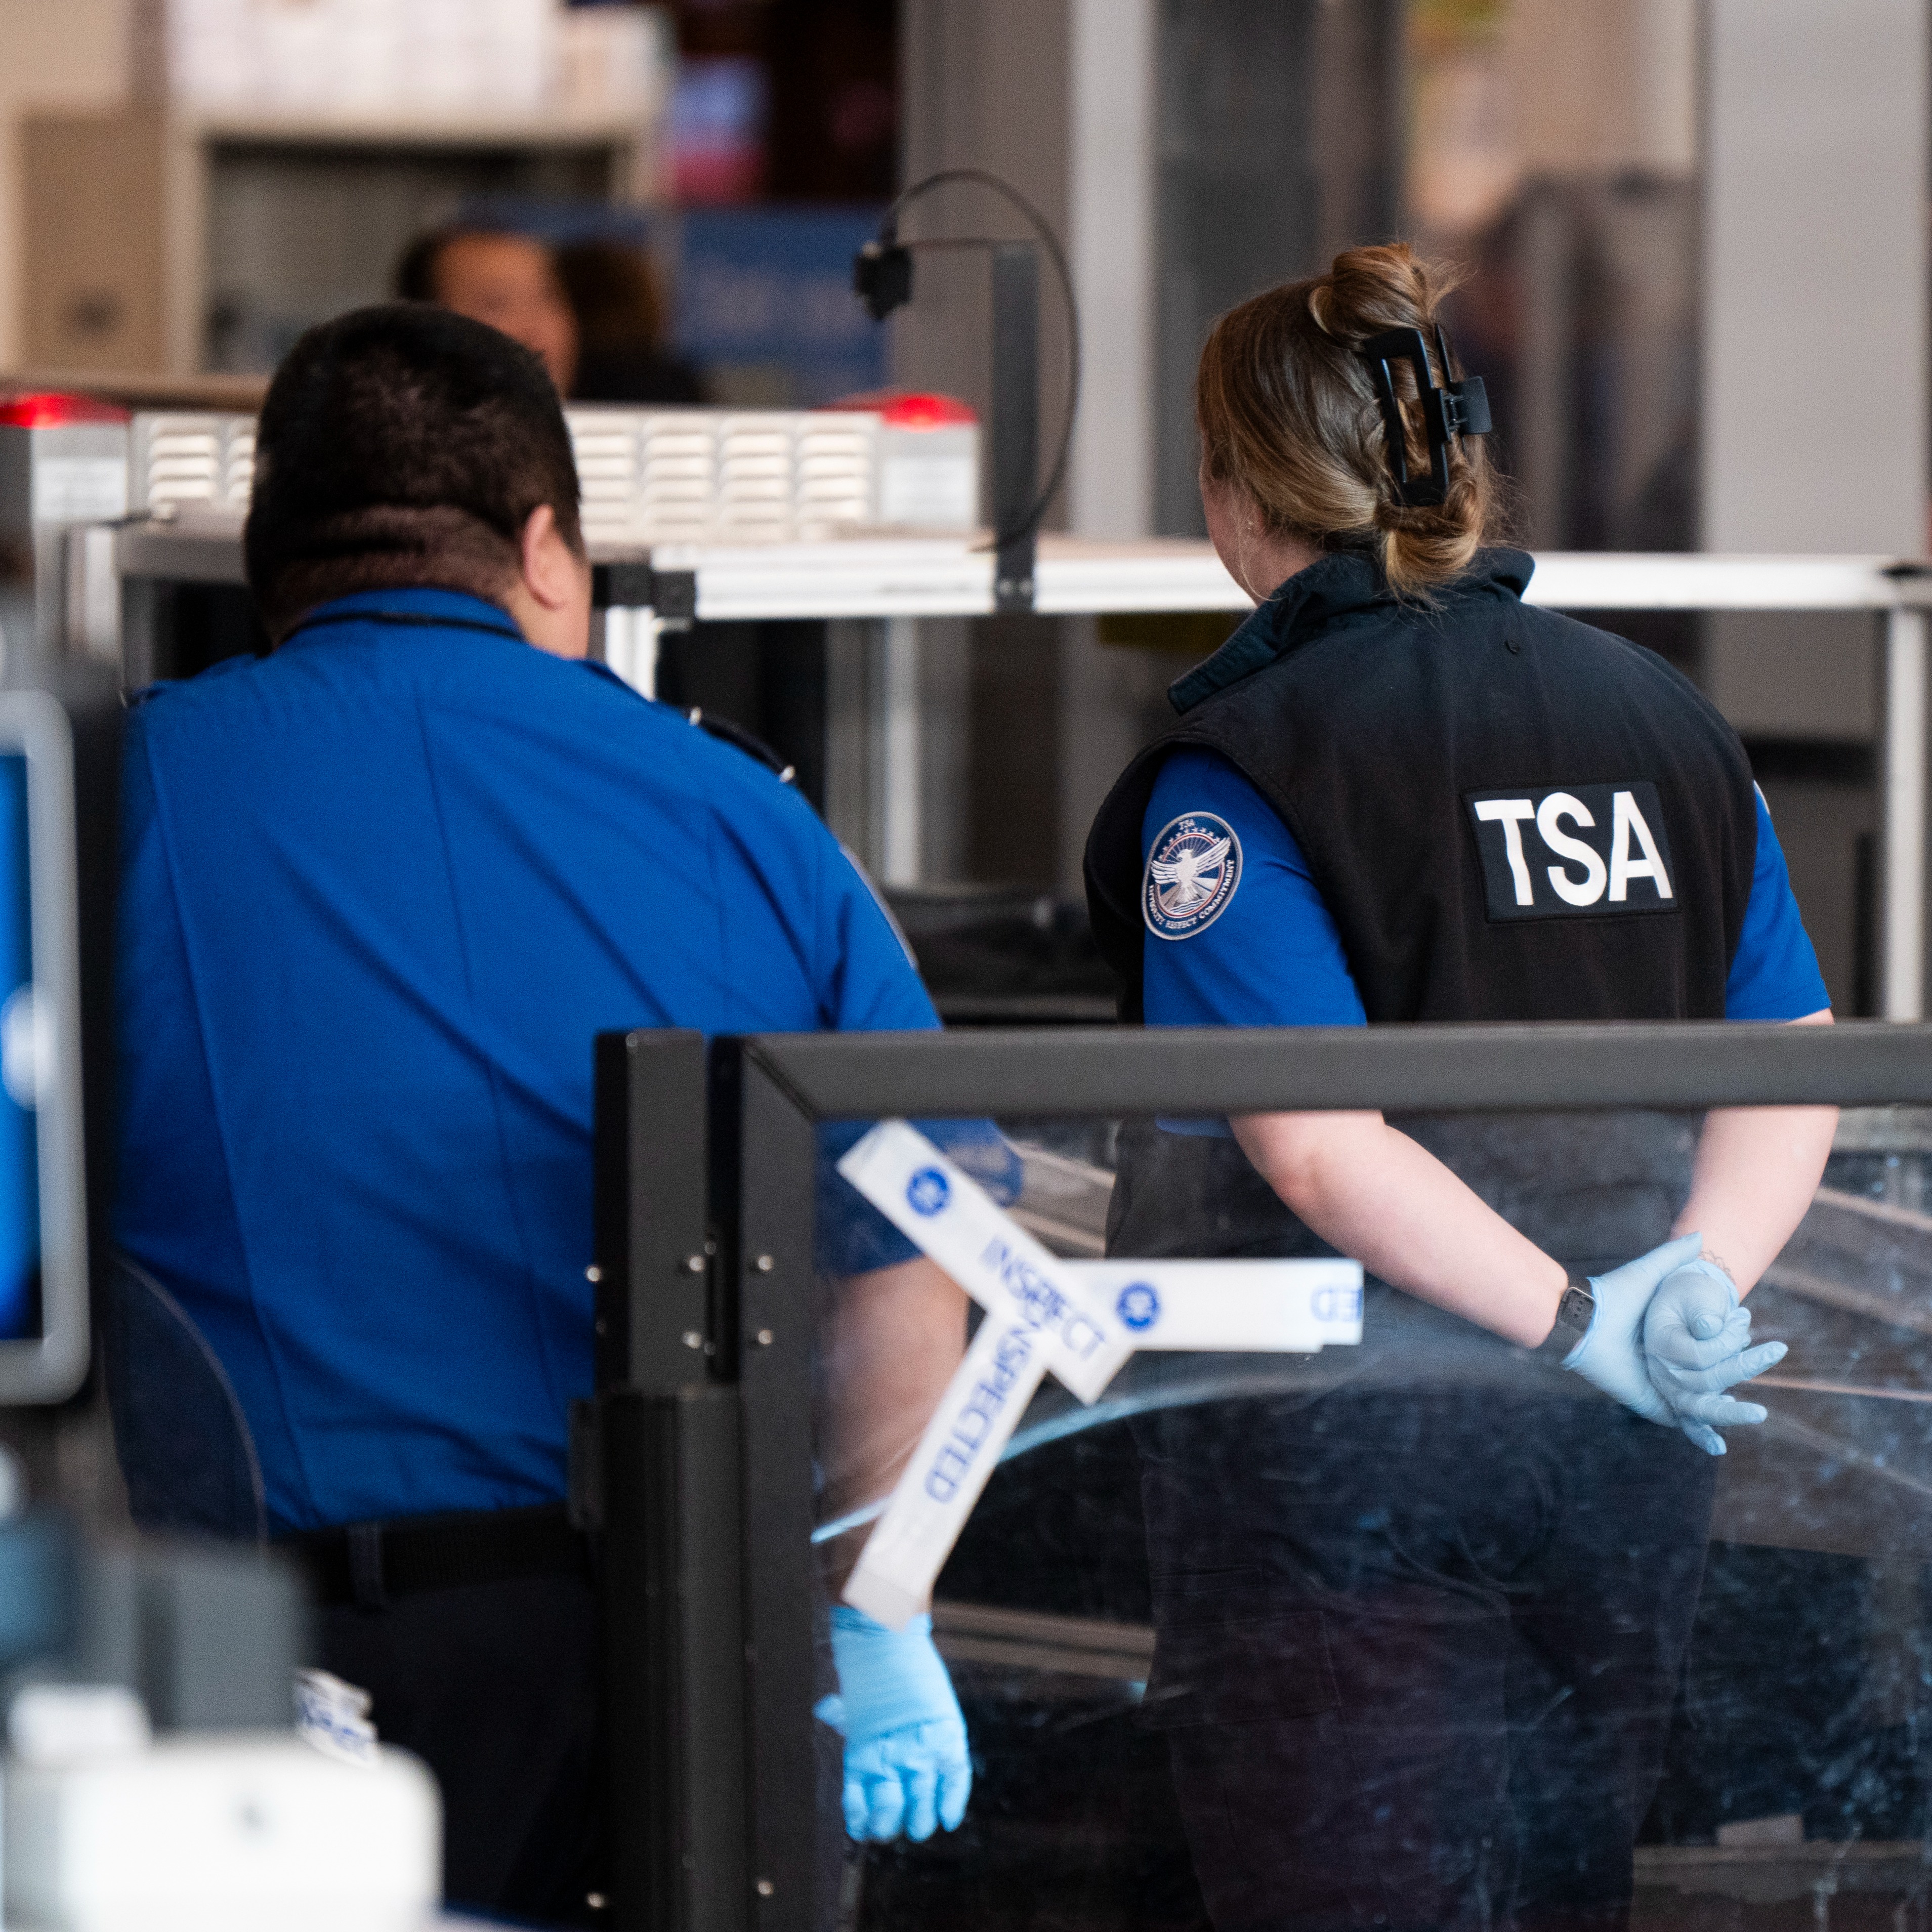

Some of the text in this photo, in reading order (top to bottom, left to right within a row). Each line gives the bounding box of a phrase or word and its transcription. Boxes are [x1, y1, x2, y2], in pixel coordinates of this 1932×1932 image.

[1179, 818, 1195, 830] TSA
[1475, 791, 1673, 906] TSA
[1199, 860, 1235, 919] COMMITMENT
